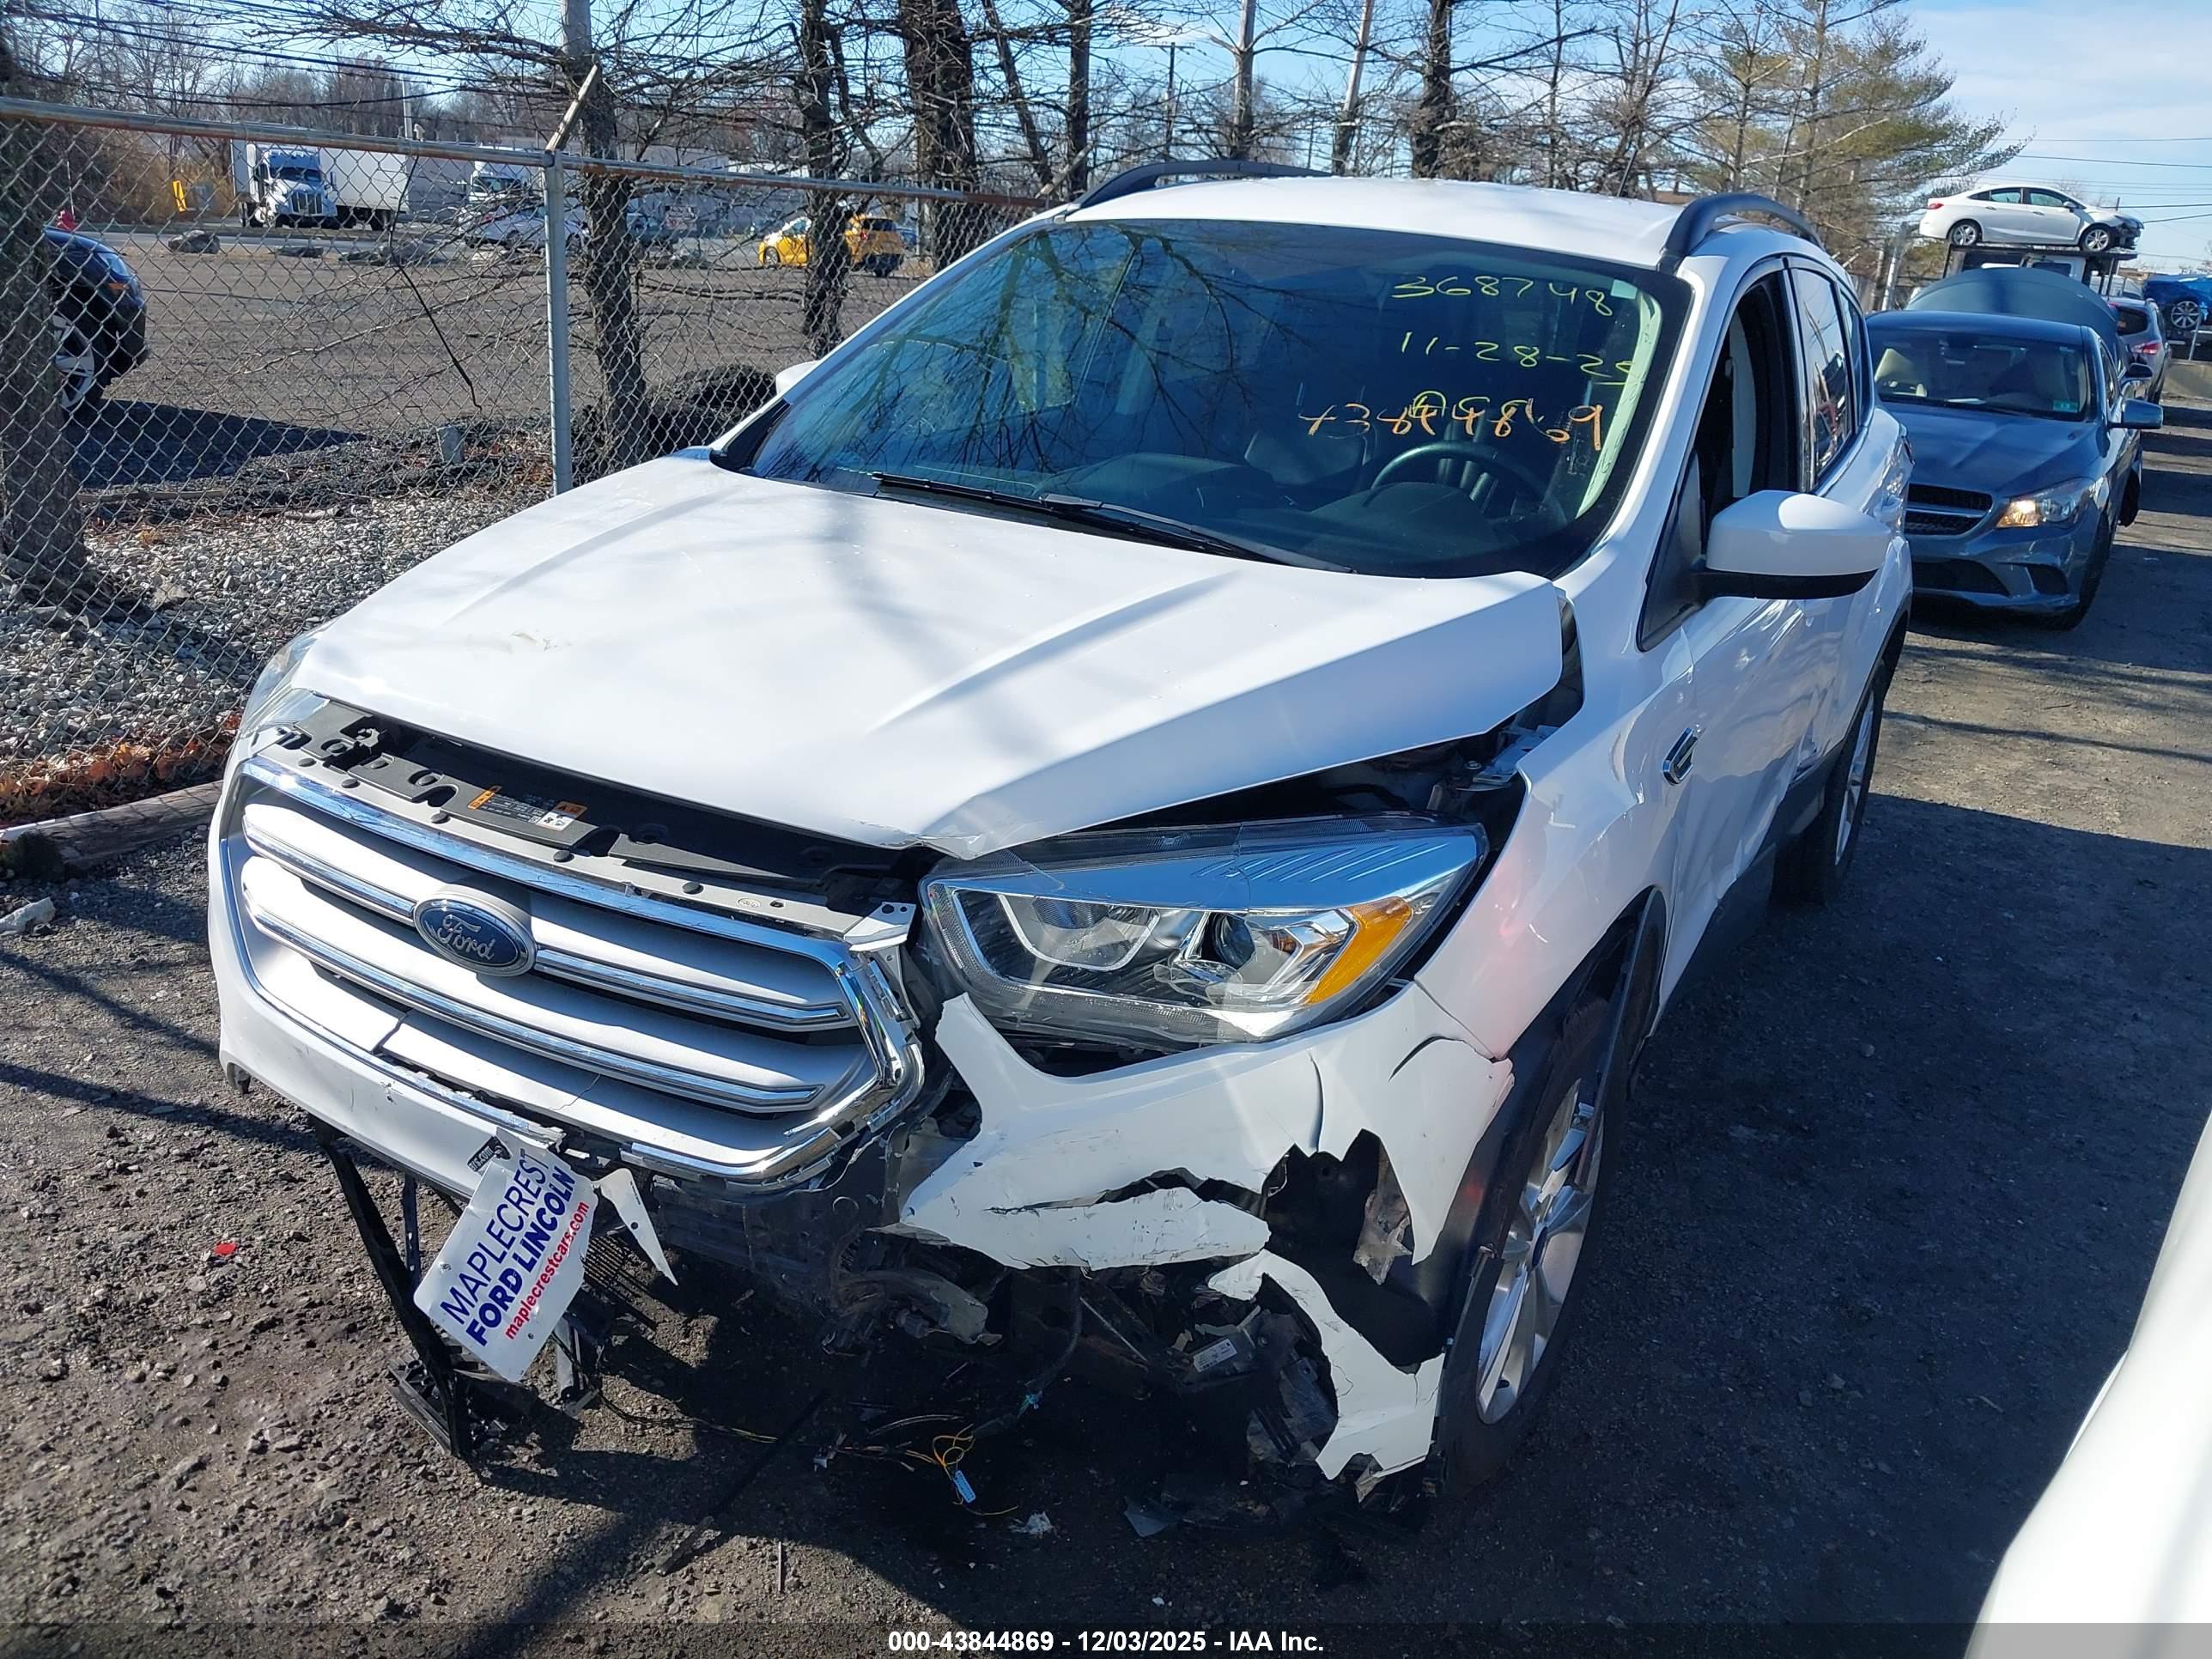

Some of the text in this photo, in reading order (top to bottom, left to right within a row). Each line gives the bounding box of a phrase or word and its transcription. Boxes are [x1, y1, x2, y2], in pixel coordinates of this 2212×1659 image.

[1391, 276, 1613, 317] 368748
[437, 914, 495, 960] Ford
[439, 1147, 550, 1325] MAPLECREST
[465, 1165, 576, 1347] FORD LINCOLN
[505, 1200, 590, 1340] maplecrestcars.com
